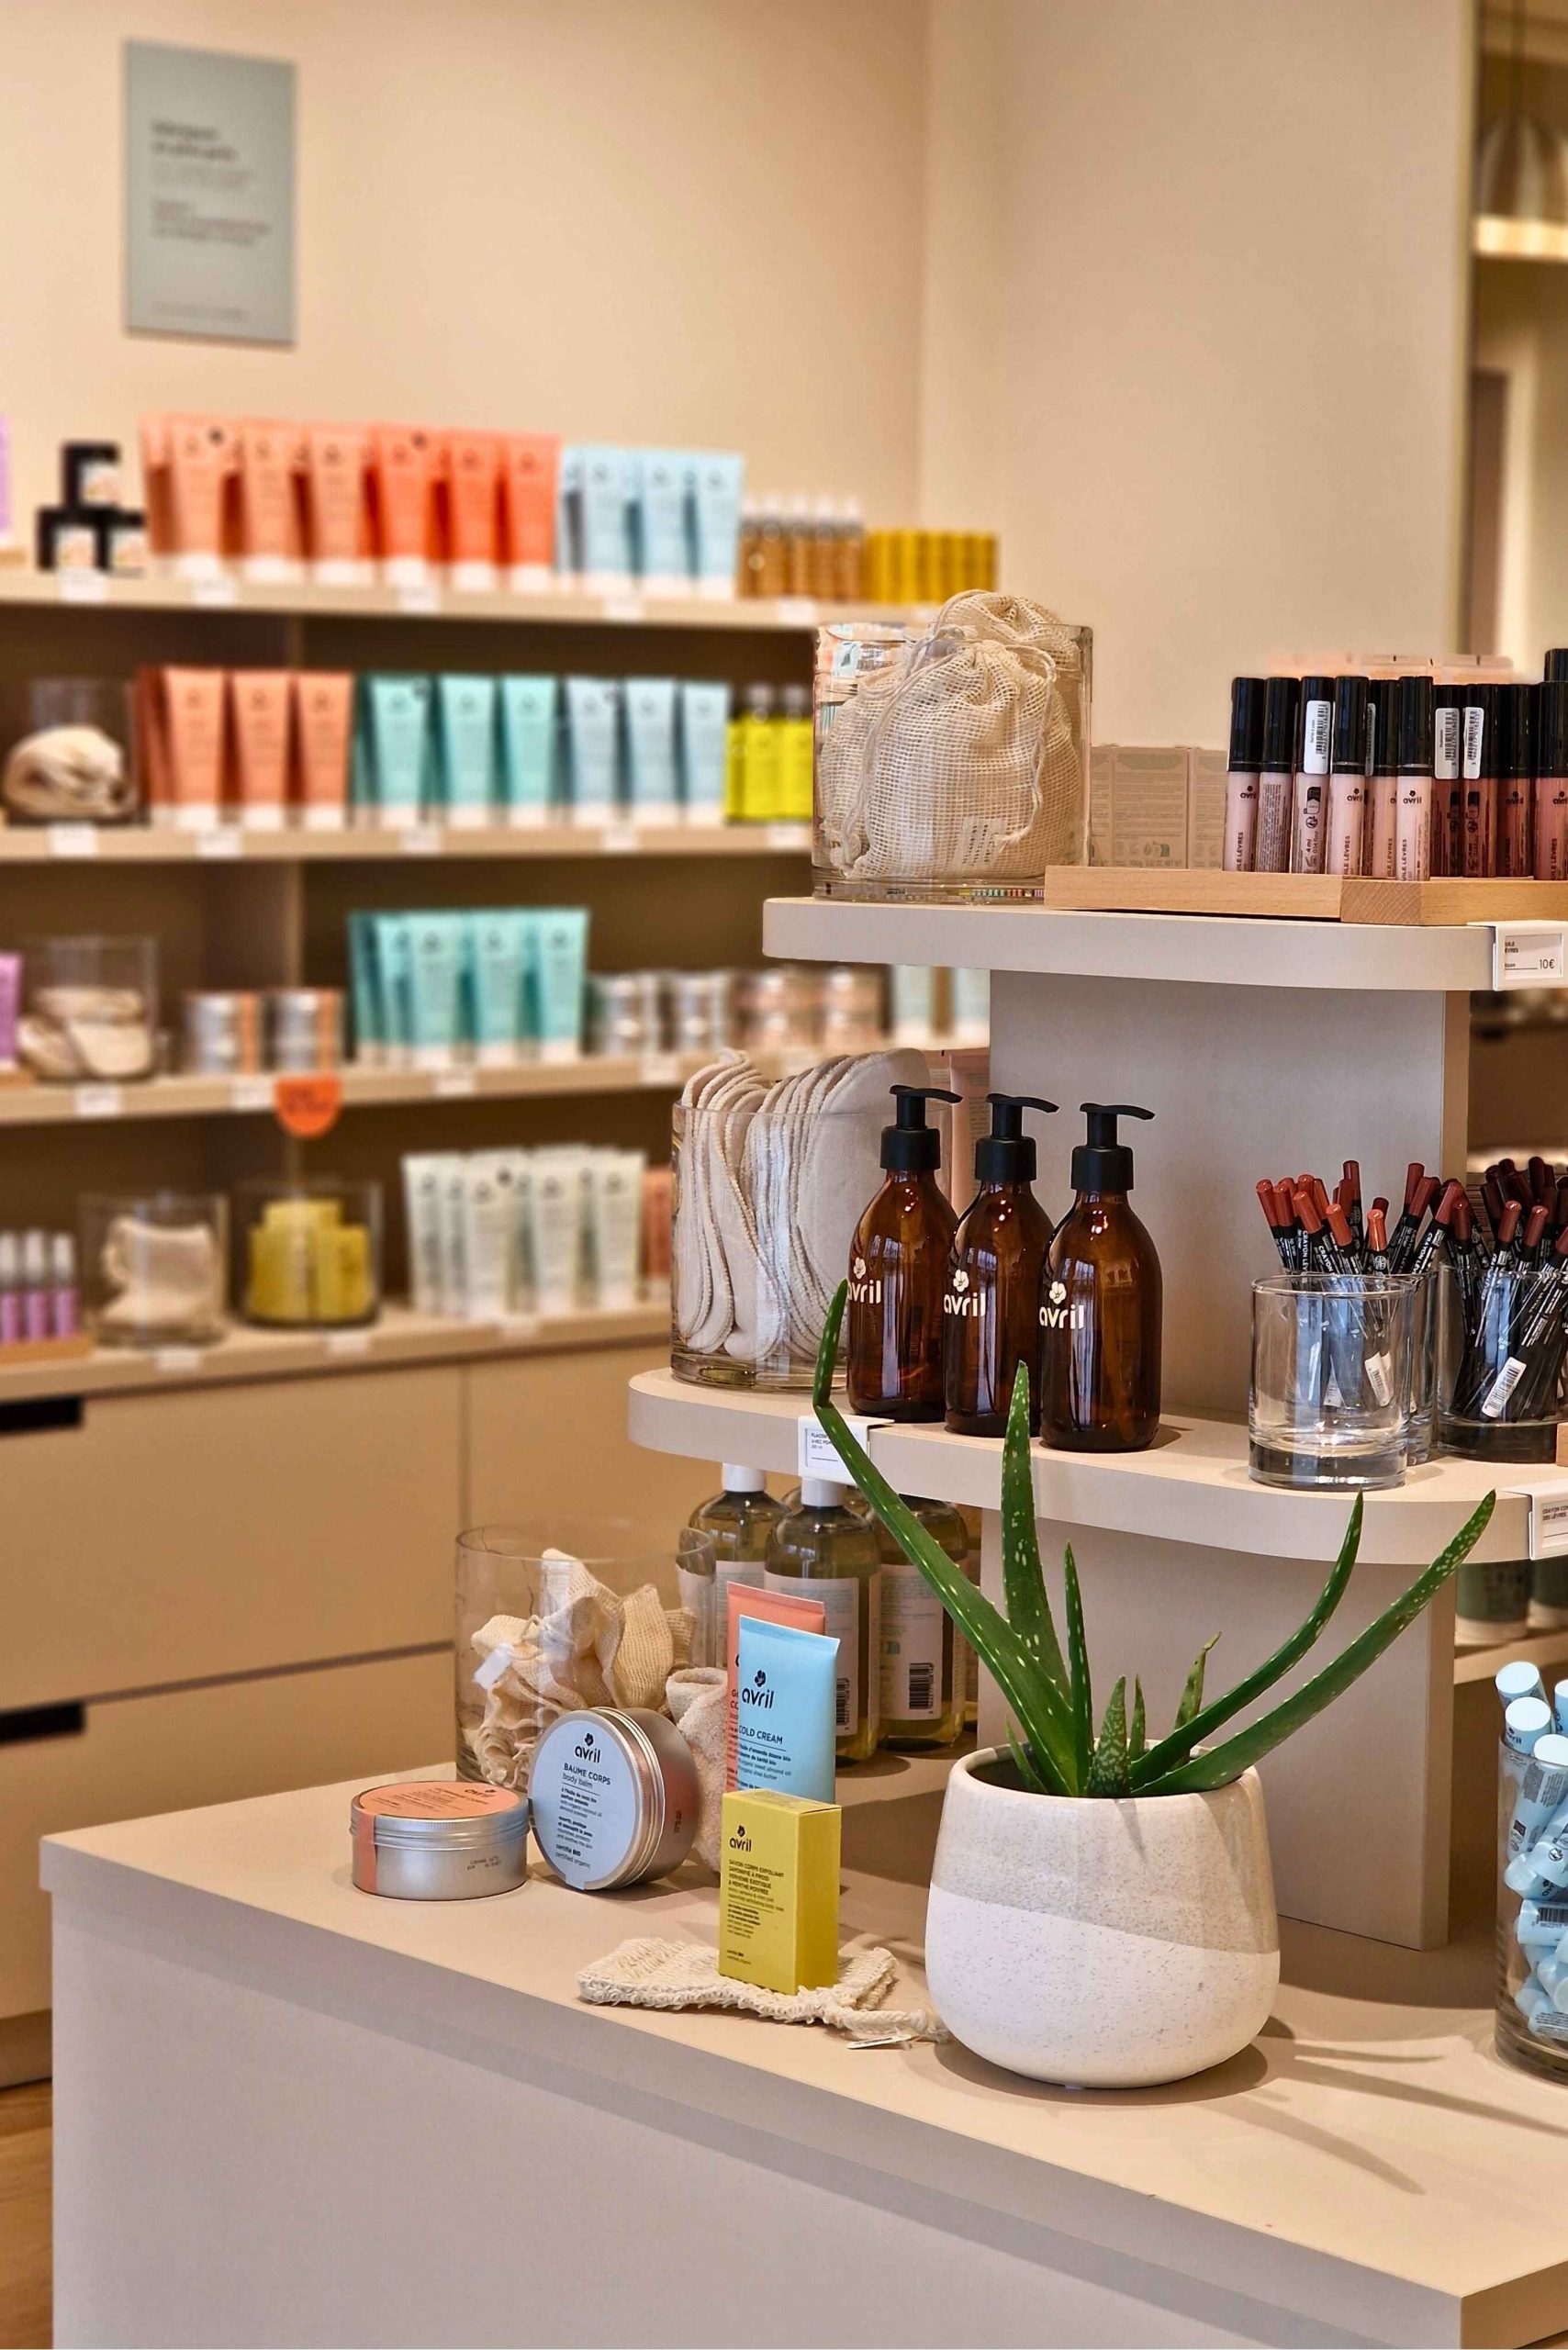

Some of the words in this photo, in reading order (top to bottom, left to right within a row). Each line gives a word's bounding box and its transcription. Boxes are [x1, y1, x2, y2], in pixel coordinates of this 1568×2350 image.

[1539, 959, 1555, 969] 10€
[1418, 1232, 1433, 1260] CRAYON
[1319, 1245, 1333, 1272] CRAYON
[847, 1279, 881, 1305] avril
[944, 1292, 986, 1317] avril
[1039, 1304, 1084, 1330] avril
[742, 1688, 774, 1709] avril
[739, 1725, 755, 1737] COLD
[757, 1731, 783, 1744] CREAM
[574, 1745, 601, 1763] avril
[563, 1763, 587, 1778] BAUME
[588, 1771, 611, 1785] CORPS
[563, 1773, 577, 1786] body
[579, 1778, 593, 1789] balm
[729, 1837, 752, 1852] avril
